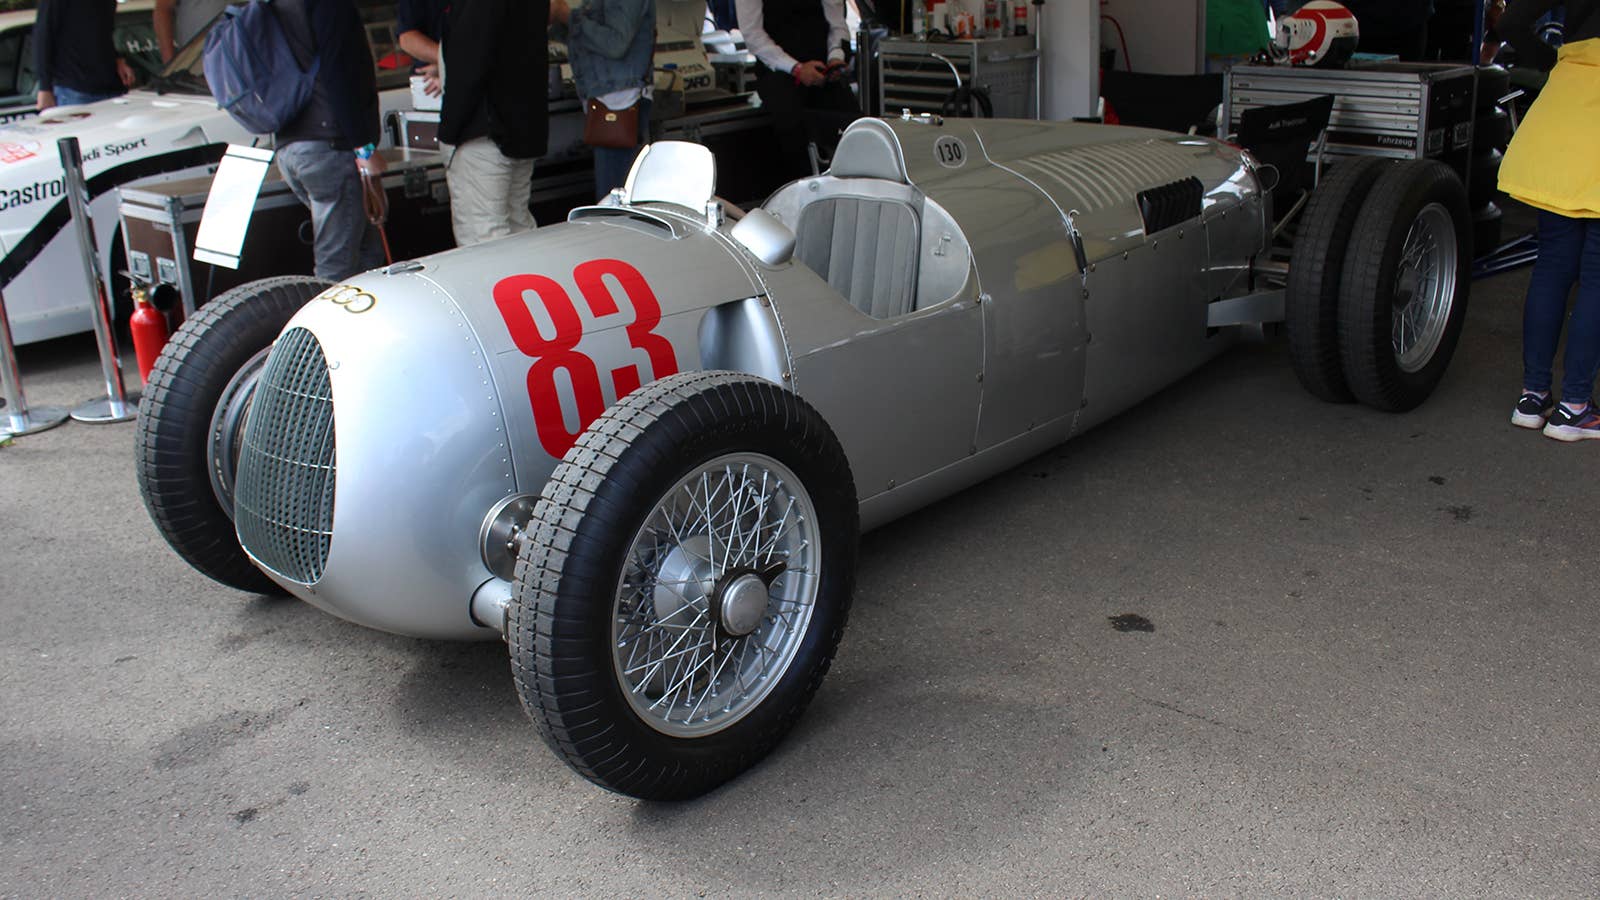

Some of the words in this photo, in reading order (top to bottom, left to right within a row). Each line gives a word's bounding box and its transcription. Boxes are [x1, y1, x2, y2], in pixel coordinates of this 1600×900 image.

[82, 150, 101, 163] udi
[105, 138, 147, 156] Sport
[938, 142, 962, 163] 130
[493, 258, 679, 460] 83
